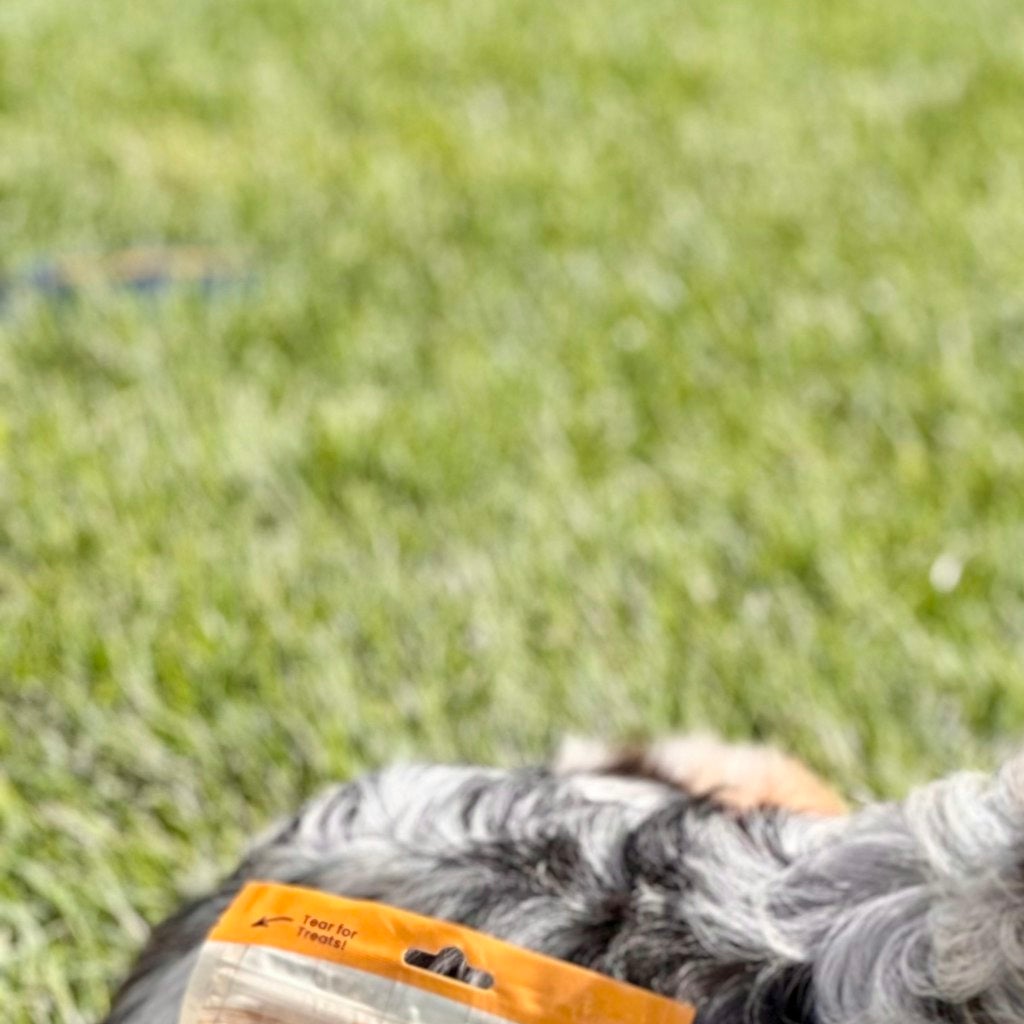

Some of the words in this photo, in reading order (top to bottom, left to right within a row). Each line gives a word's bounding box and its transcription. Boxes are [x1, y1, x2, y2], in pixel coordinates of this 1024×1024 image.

[297, 926, 347, 951] Treats!
[303, 914, 334, 932] Tear
[336, 923, 358, 939] for
